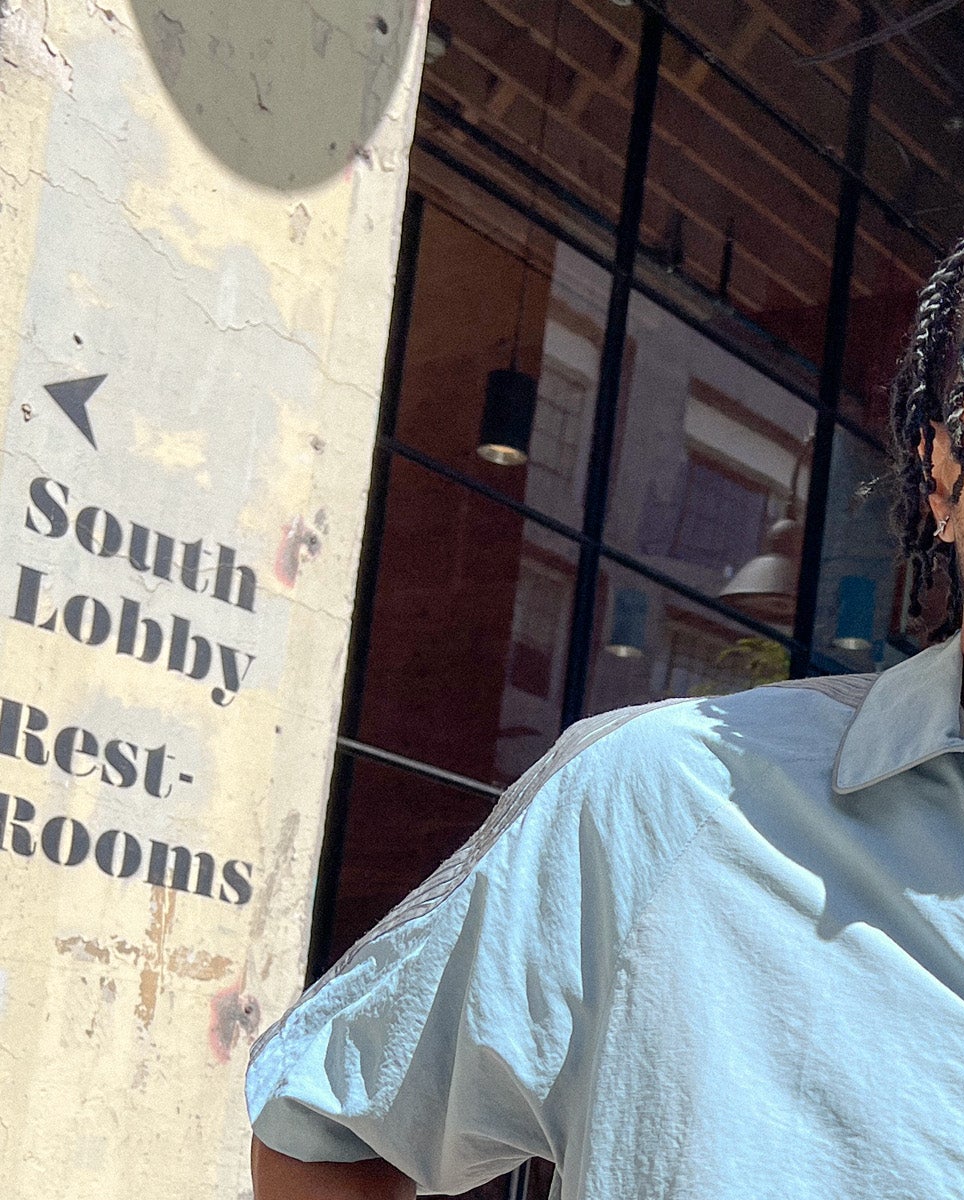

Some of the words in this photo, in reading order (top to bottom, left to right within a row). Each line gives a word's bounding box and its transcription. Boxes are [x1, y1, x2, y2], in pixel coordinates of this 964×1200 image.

[25, 476, 256, 613] South
[10, 563, 255, 707] Lobby
[0, 696, 194, 799] Rest-
